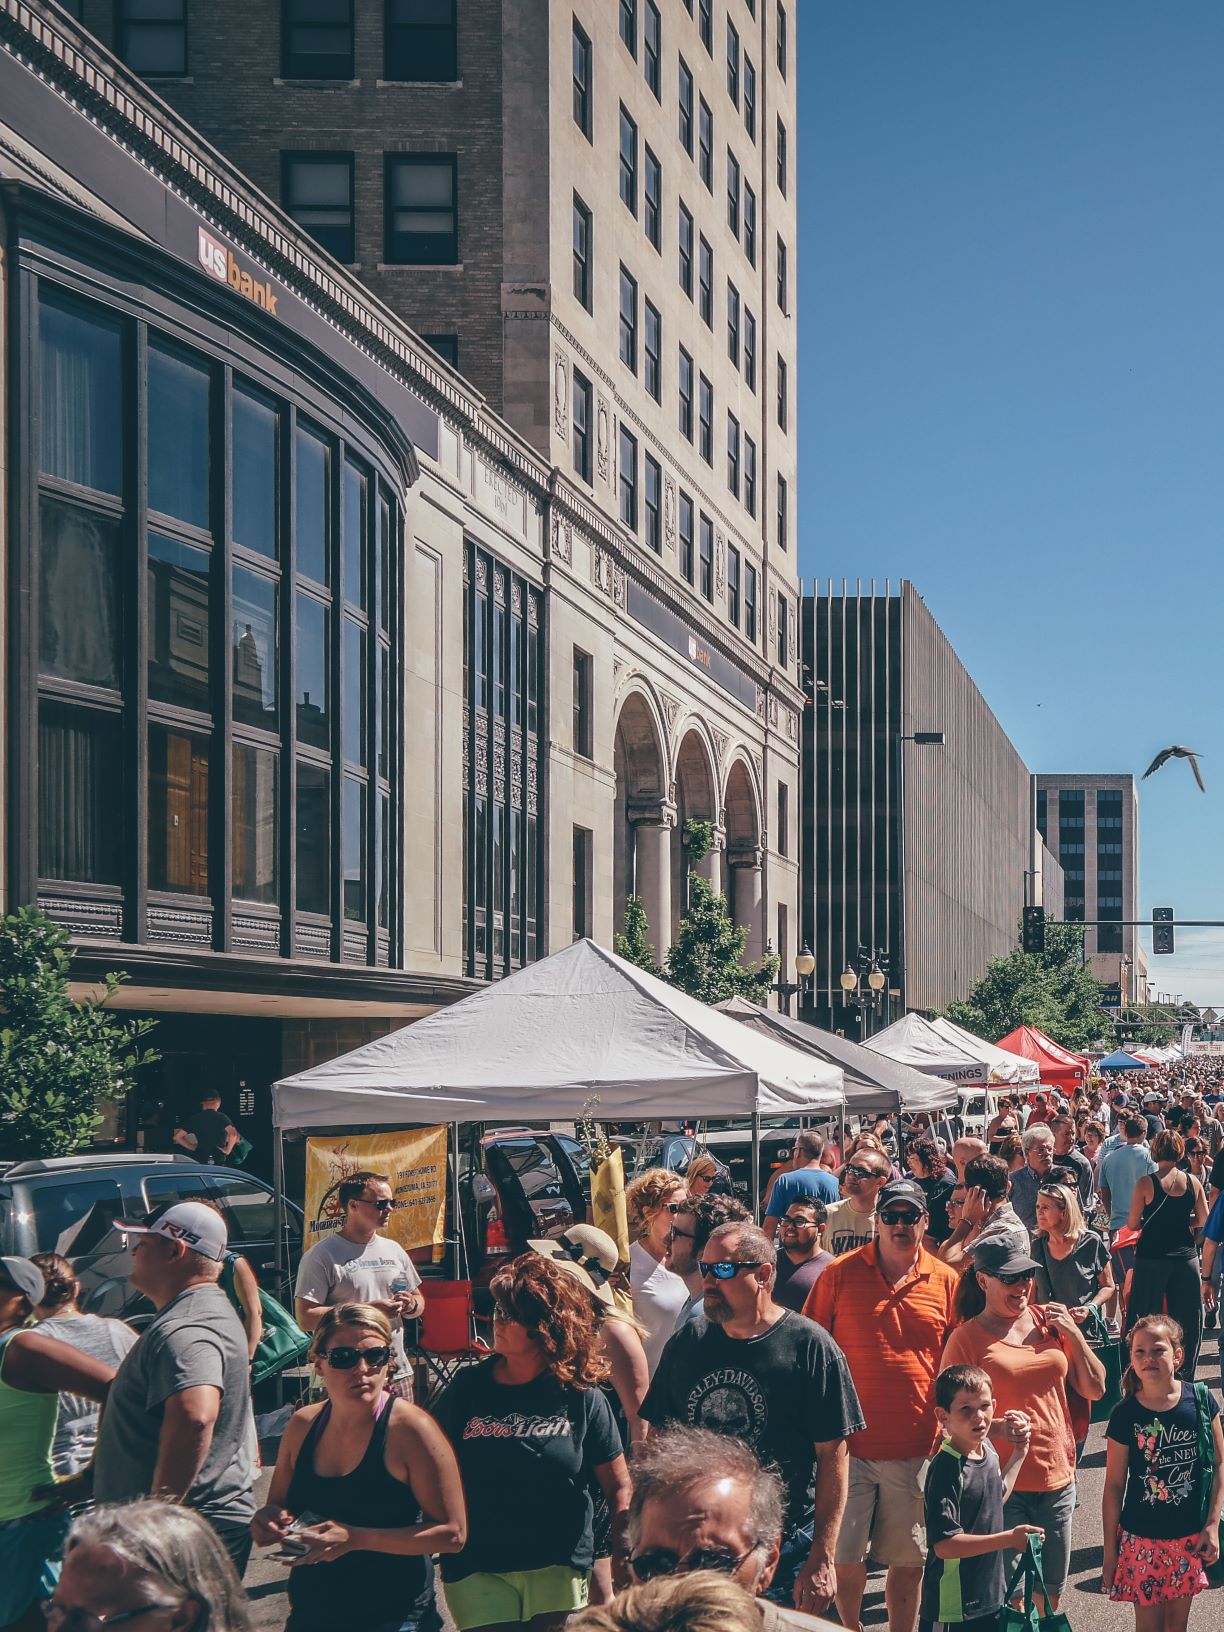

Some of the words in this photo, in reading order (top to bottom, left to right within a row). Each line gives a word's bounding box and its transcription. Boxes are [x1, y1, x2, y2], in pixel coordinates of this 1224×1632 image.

[938, 1068, 983, 1081] ENINGS
[463, 1417, 513, 1440] Coors
[514, 1418, 571, 1437] LIGHT
[1160, 1424, 1192, 1447] Nice
[1159, 1455, 1172, 1465] the
[1174, 1447, 1198, 1462] NEW
[1168, 1462, 1194, 1485] Cool
